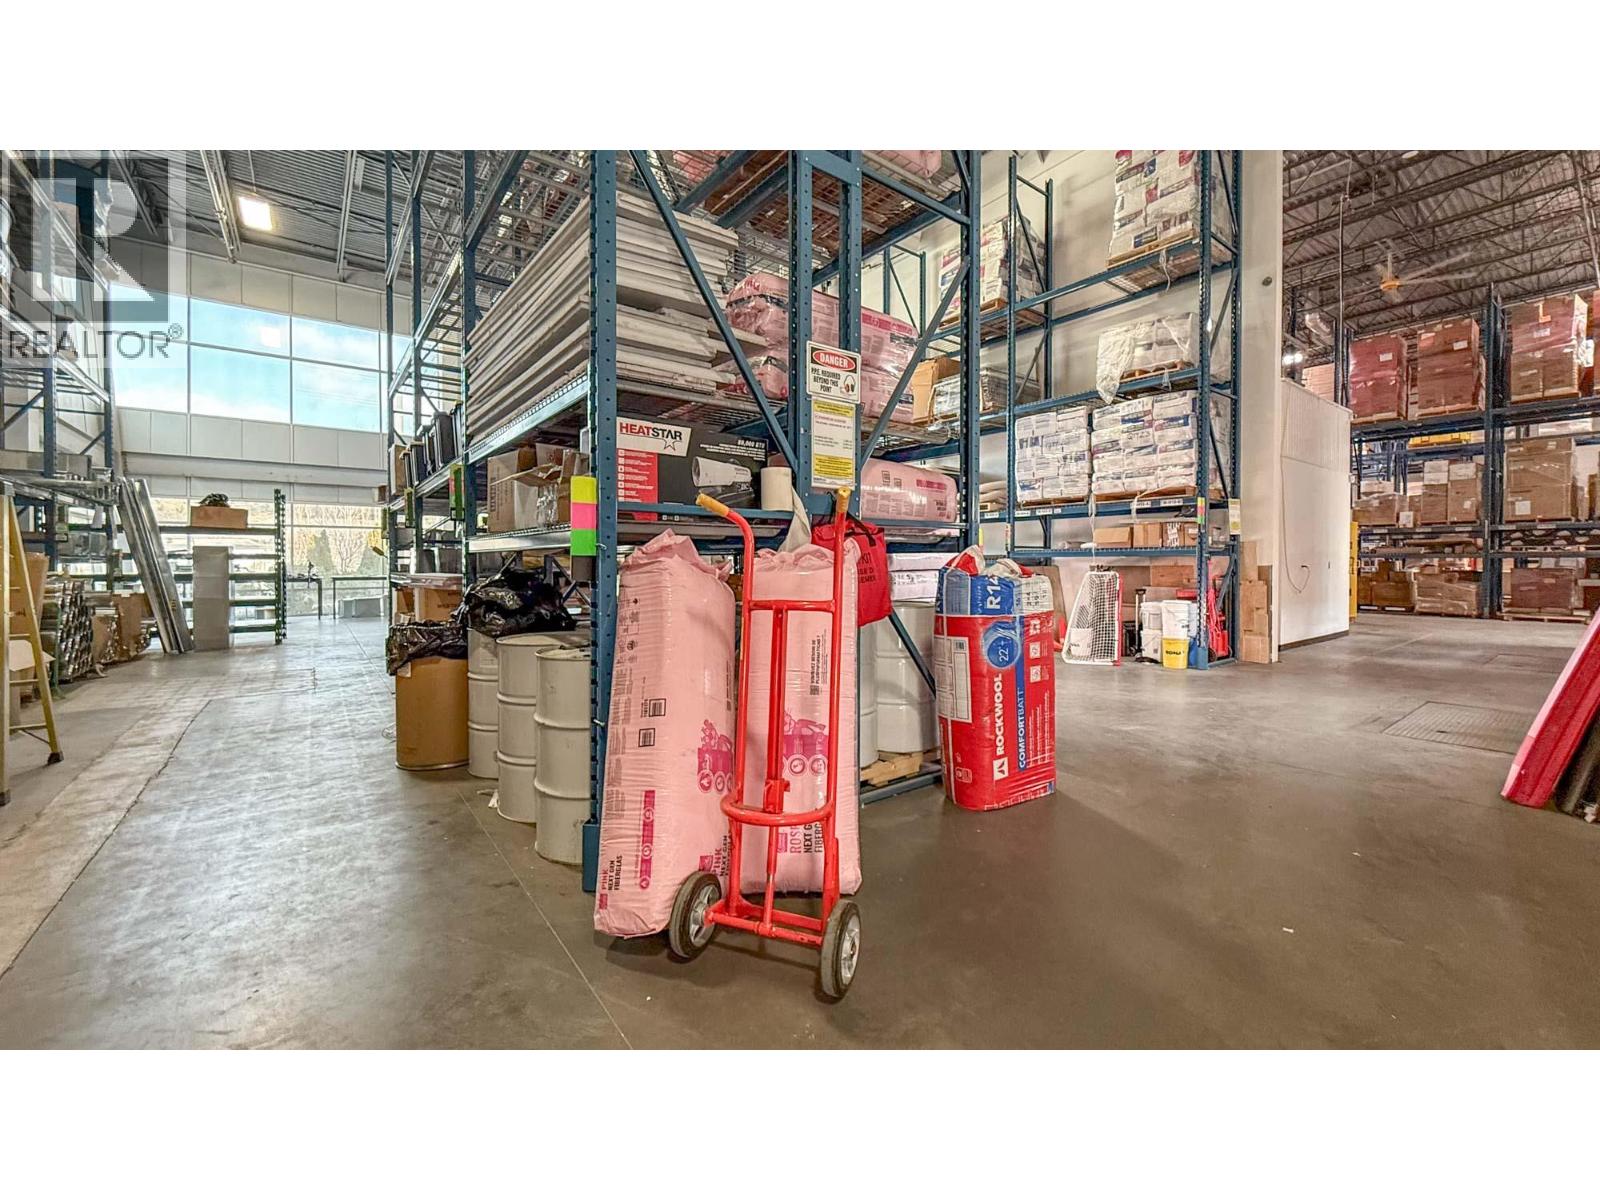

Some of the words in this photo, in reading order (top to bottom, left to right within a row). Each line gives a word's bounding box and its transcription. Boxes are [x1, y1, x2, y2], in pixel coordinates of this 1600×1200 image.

[819, 352, 849, 369] DANGER
[820, 384, 833, 393] POINT
[619, 422, 682, 441] HEATSTAR
[994, 673, 1005, 755] ROCKWOOL
[1018, 688, 1026, 768] COMFORTBATT
[804, 833, 812, 853] NEXT
[614, 855, 622, 890] FIBERGLAS
